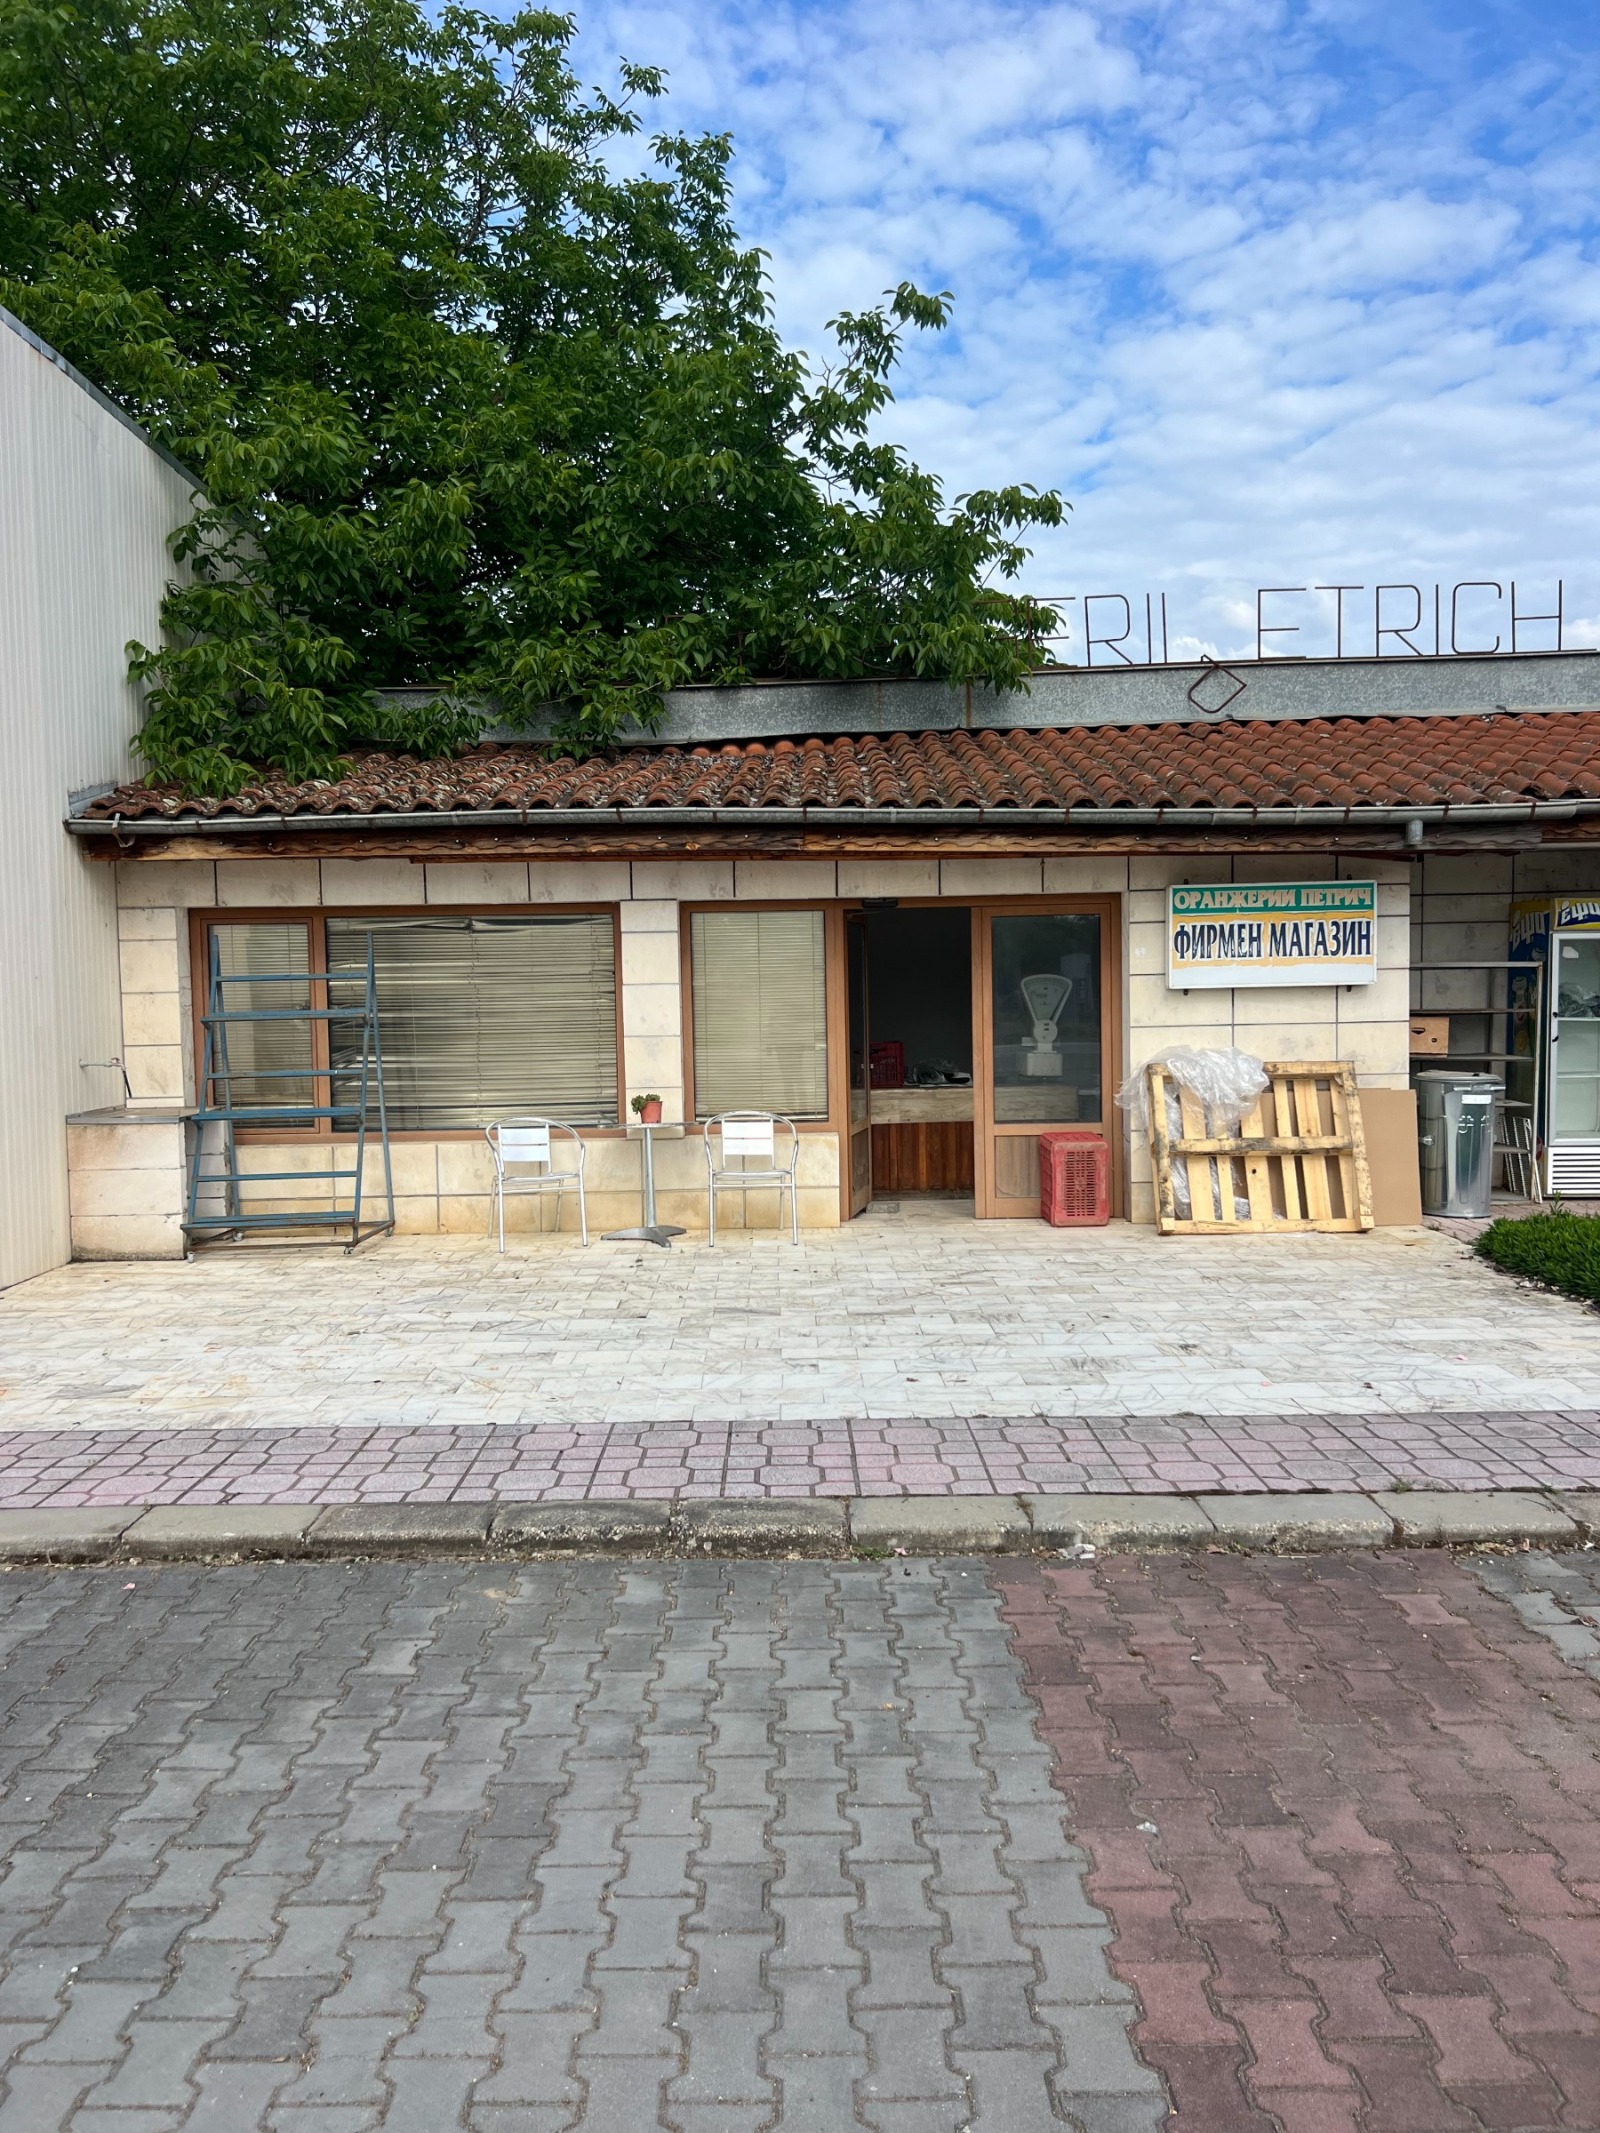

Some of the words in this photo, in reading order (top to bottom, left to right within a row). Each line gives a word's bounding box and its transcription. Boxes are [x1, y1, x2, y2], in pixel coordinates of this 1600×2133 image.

[1174, 889, 1297, 910] ОРАНЖЕРИИ
[1300, 887, 1372, 907] ПЕТРИЧ
[1173, 922, 1263, 960] ФИРМЕН
[1268, 919, 1372, 957] МАГАЗИН
